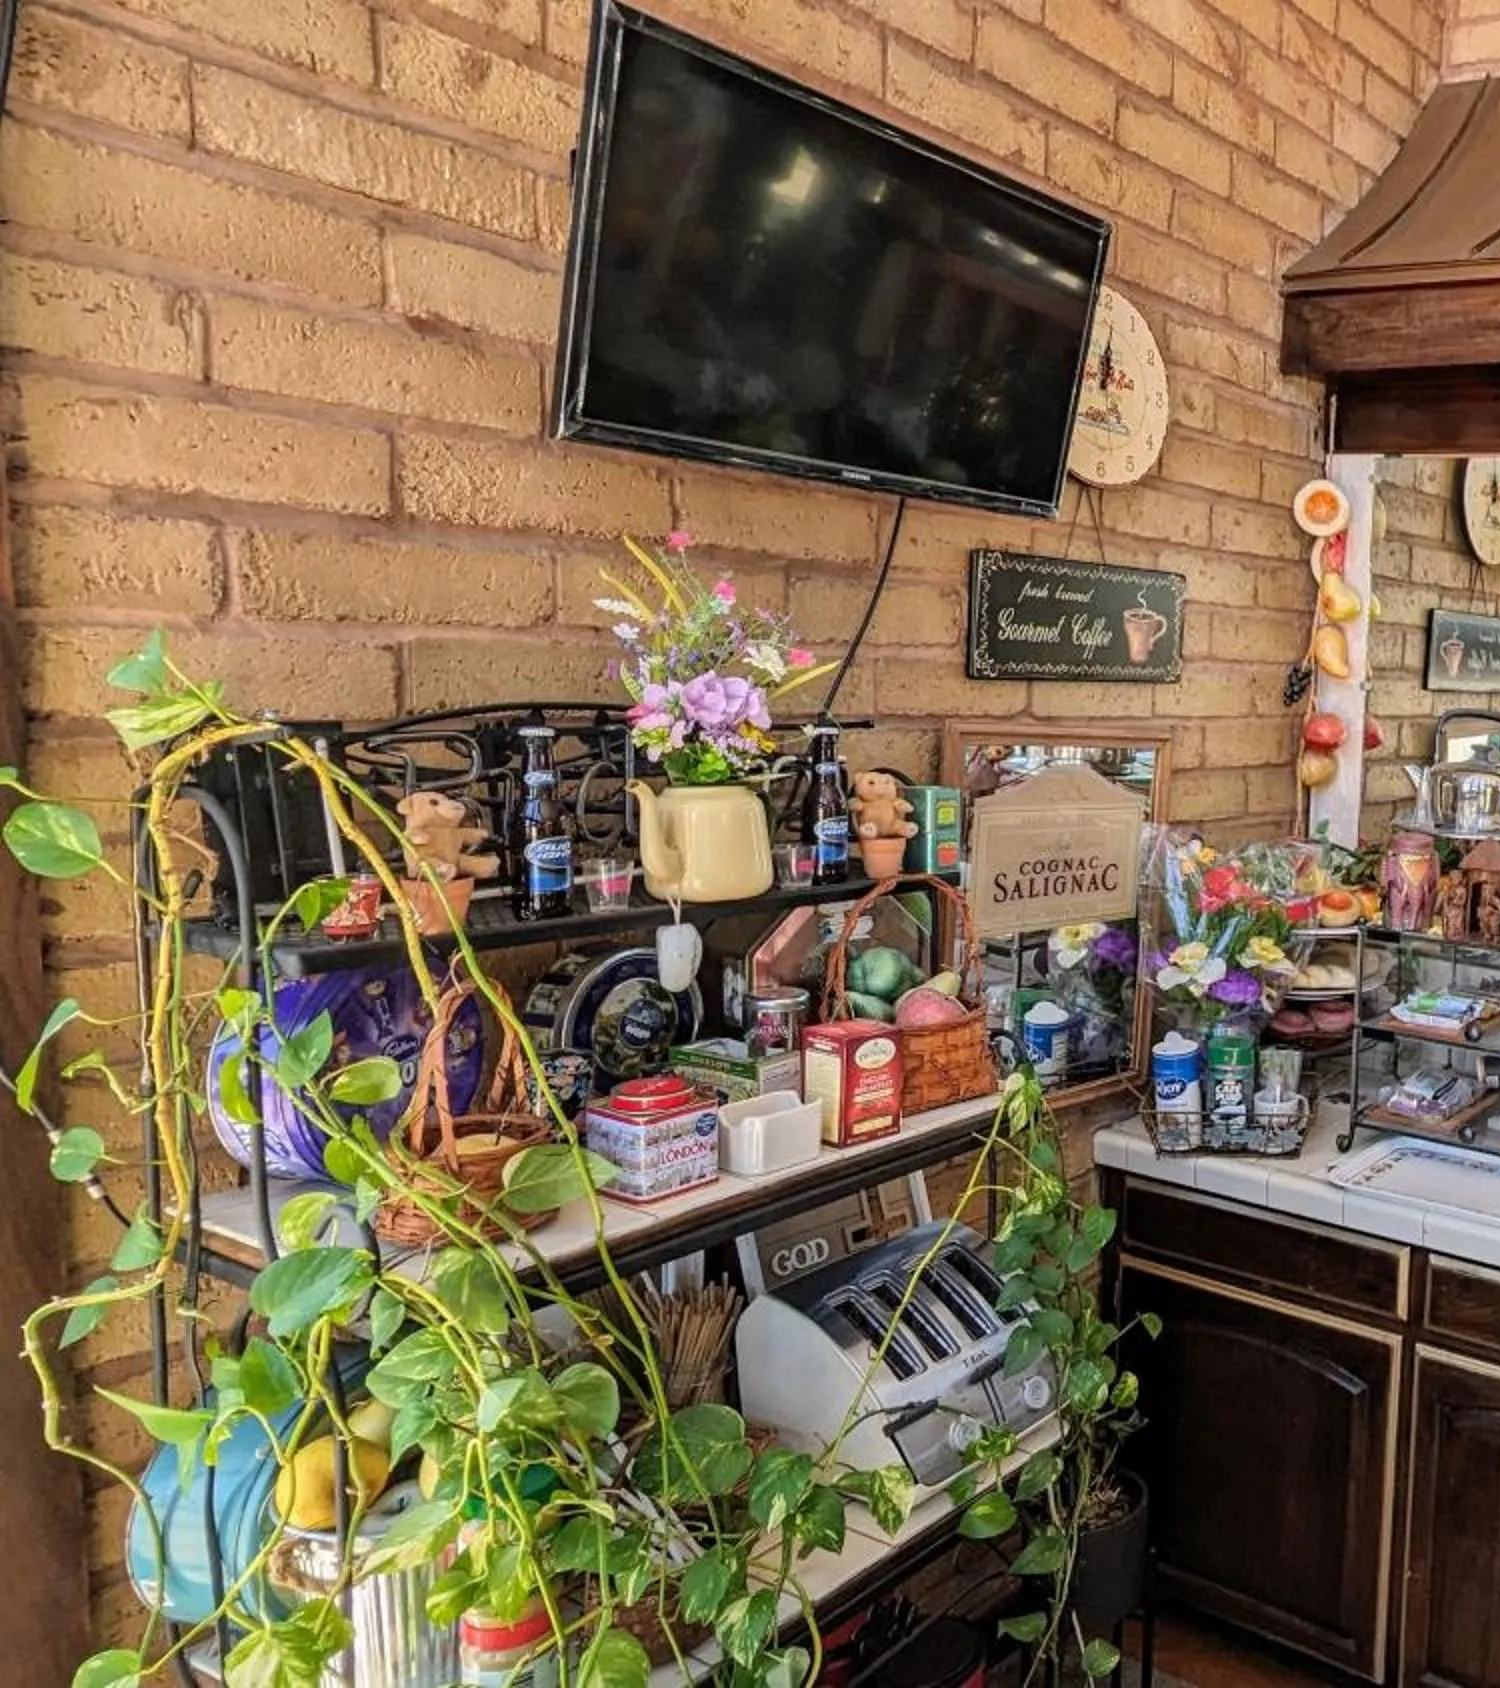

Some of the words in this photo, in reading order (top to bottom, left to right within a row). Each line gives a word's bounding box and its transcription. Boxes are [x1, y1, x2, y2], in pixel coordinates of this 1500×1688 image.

[998, 607, 1065, 644] Gourmet
[1072, 613, 1113, 659] Coffee
[993, 863, 1119, 902] SALIGNAC
[1019, 855, 1101, 876] COGNAC
[661, 1140, 709, 1165] LONDON
[772, 1237, 830, 1277] GOD
